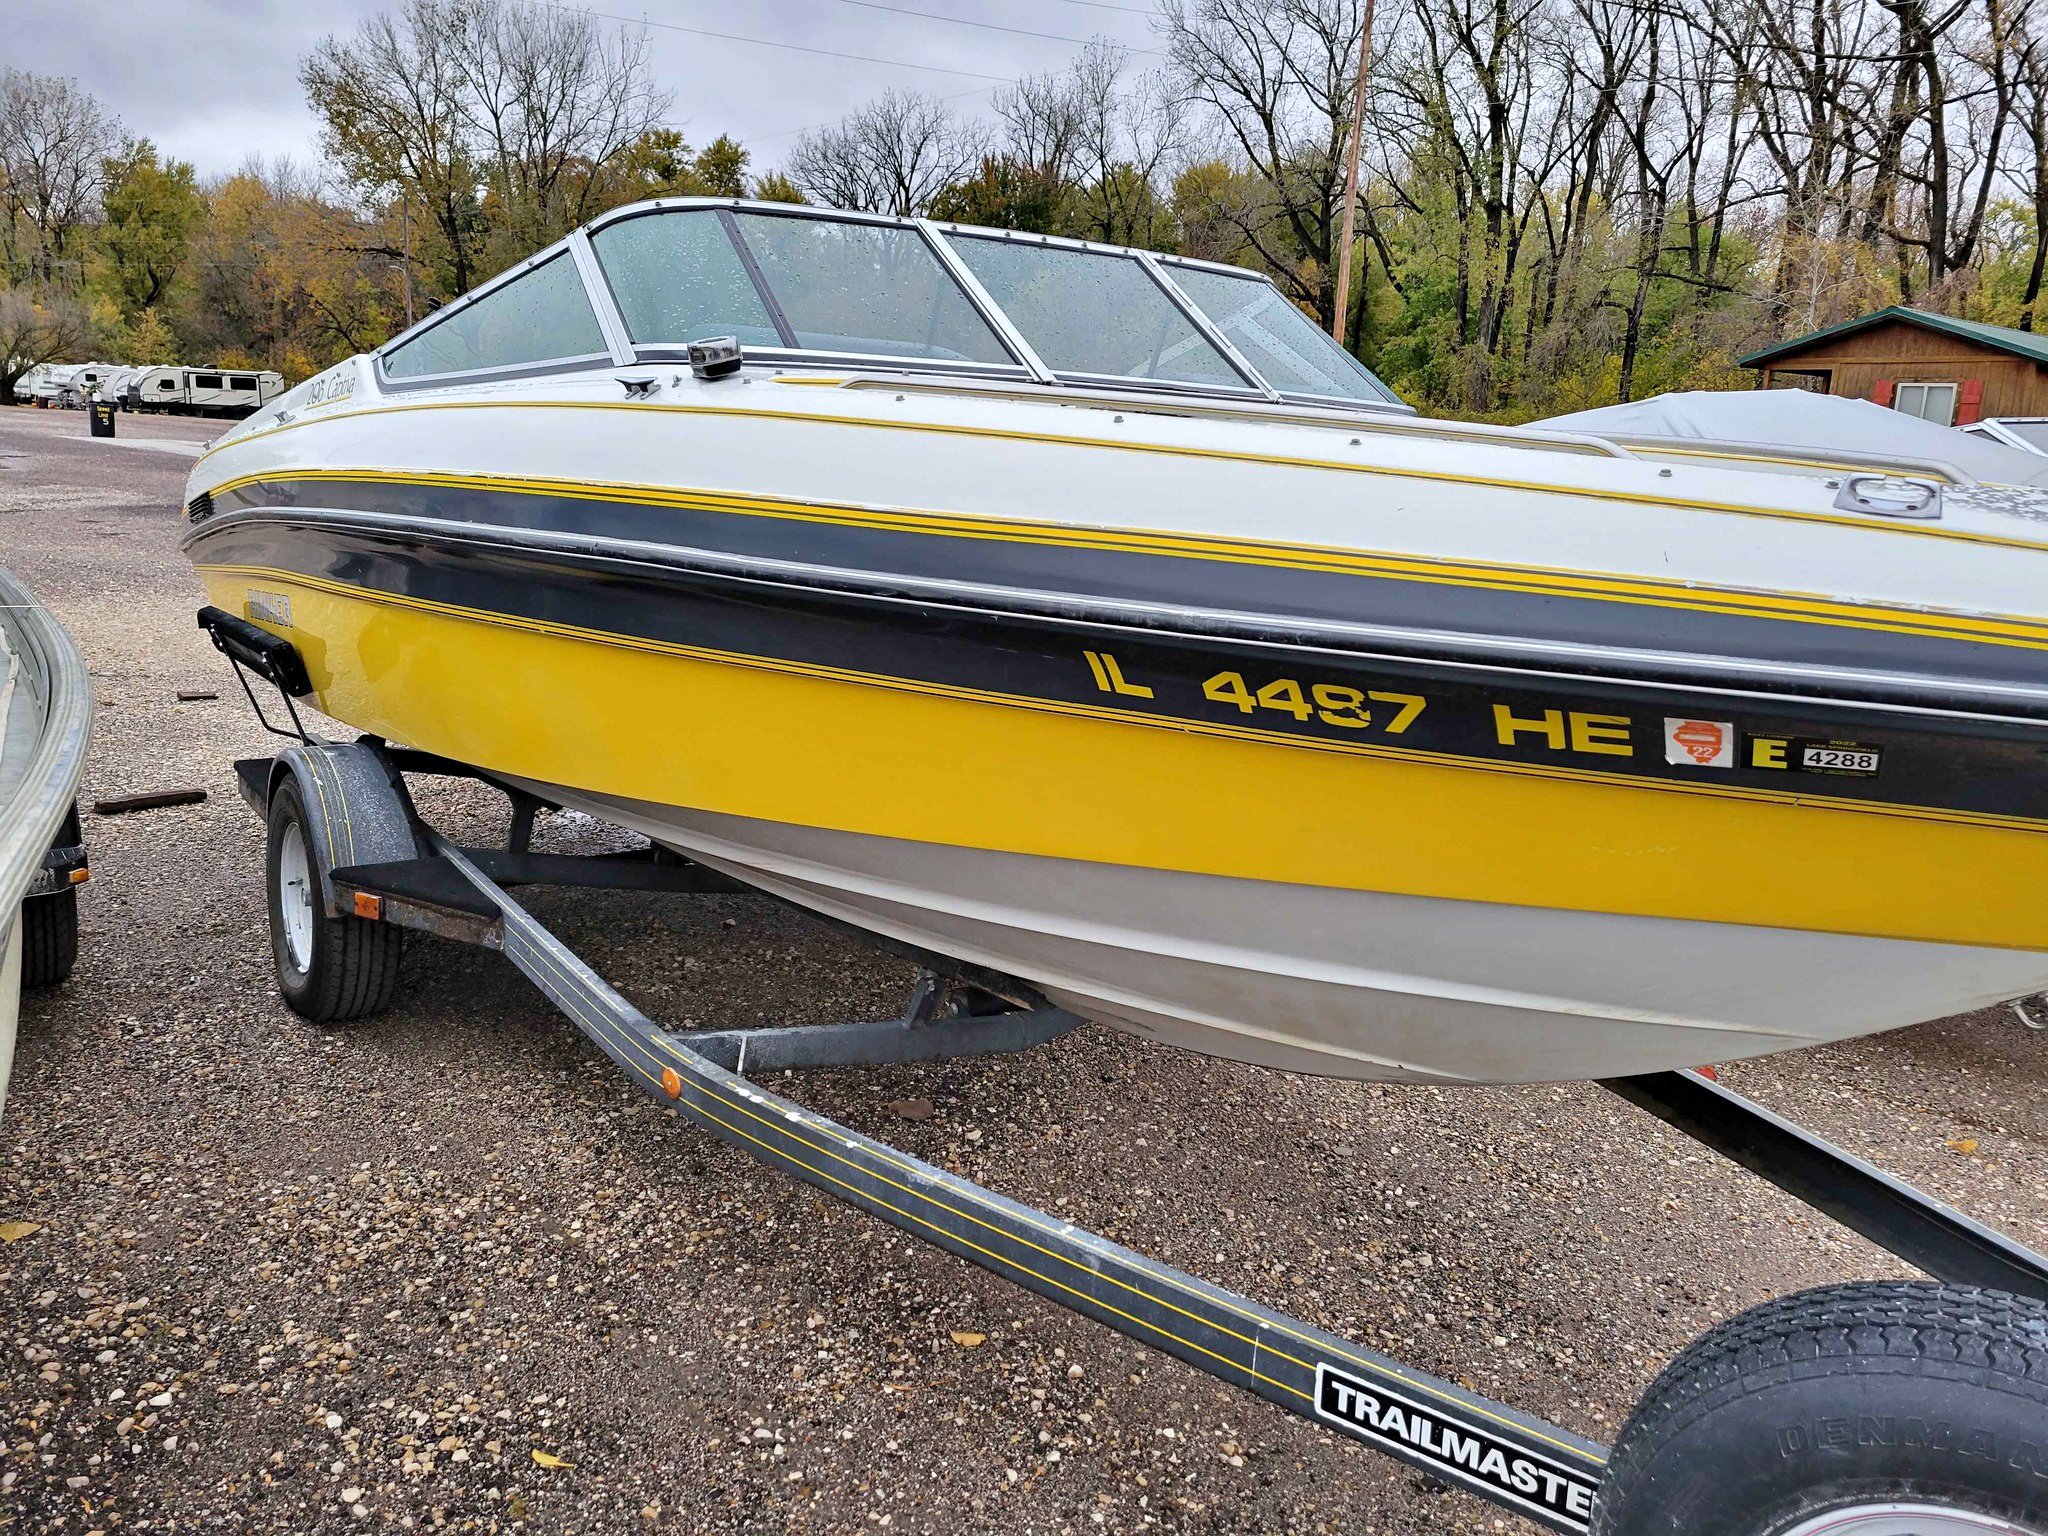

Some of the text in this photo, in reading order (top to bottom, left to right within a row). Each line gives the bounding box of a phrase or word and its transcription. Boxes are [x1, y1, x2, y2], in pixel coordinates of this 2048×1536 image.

[1082, 650, 1155, 699] IL
[1492, 704, 1634, 757] HE
[1693, 746, 1713, 758] 22
[1752, 738, 1787, 769] E
[1807, 751, 1873, 769] 4288
[1331, 1380, 1597, 1518] TRAILMASTE
